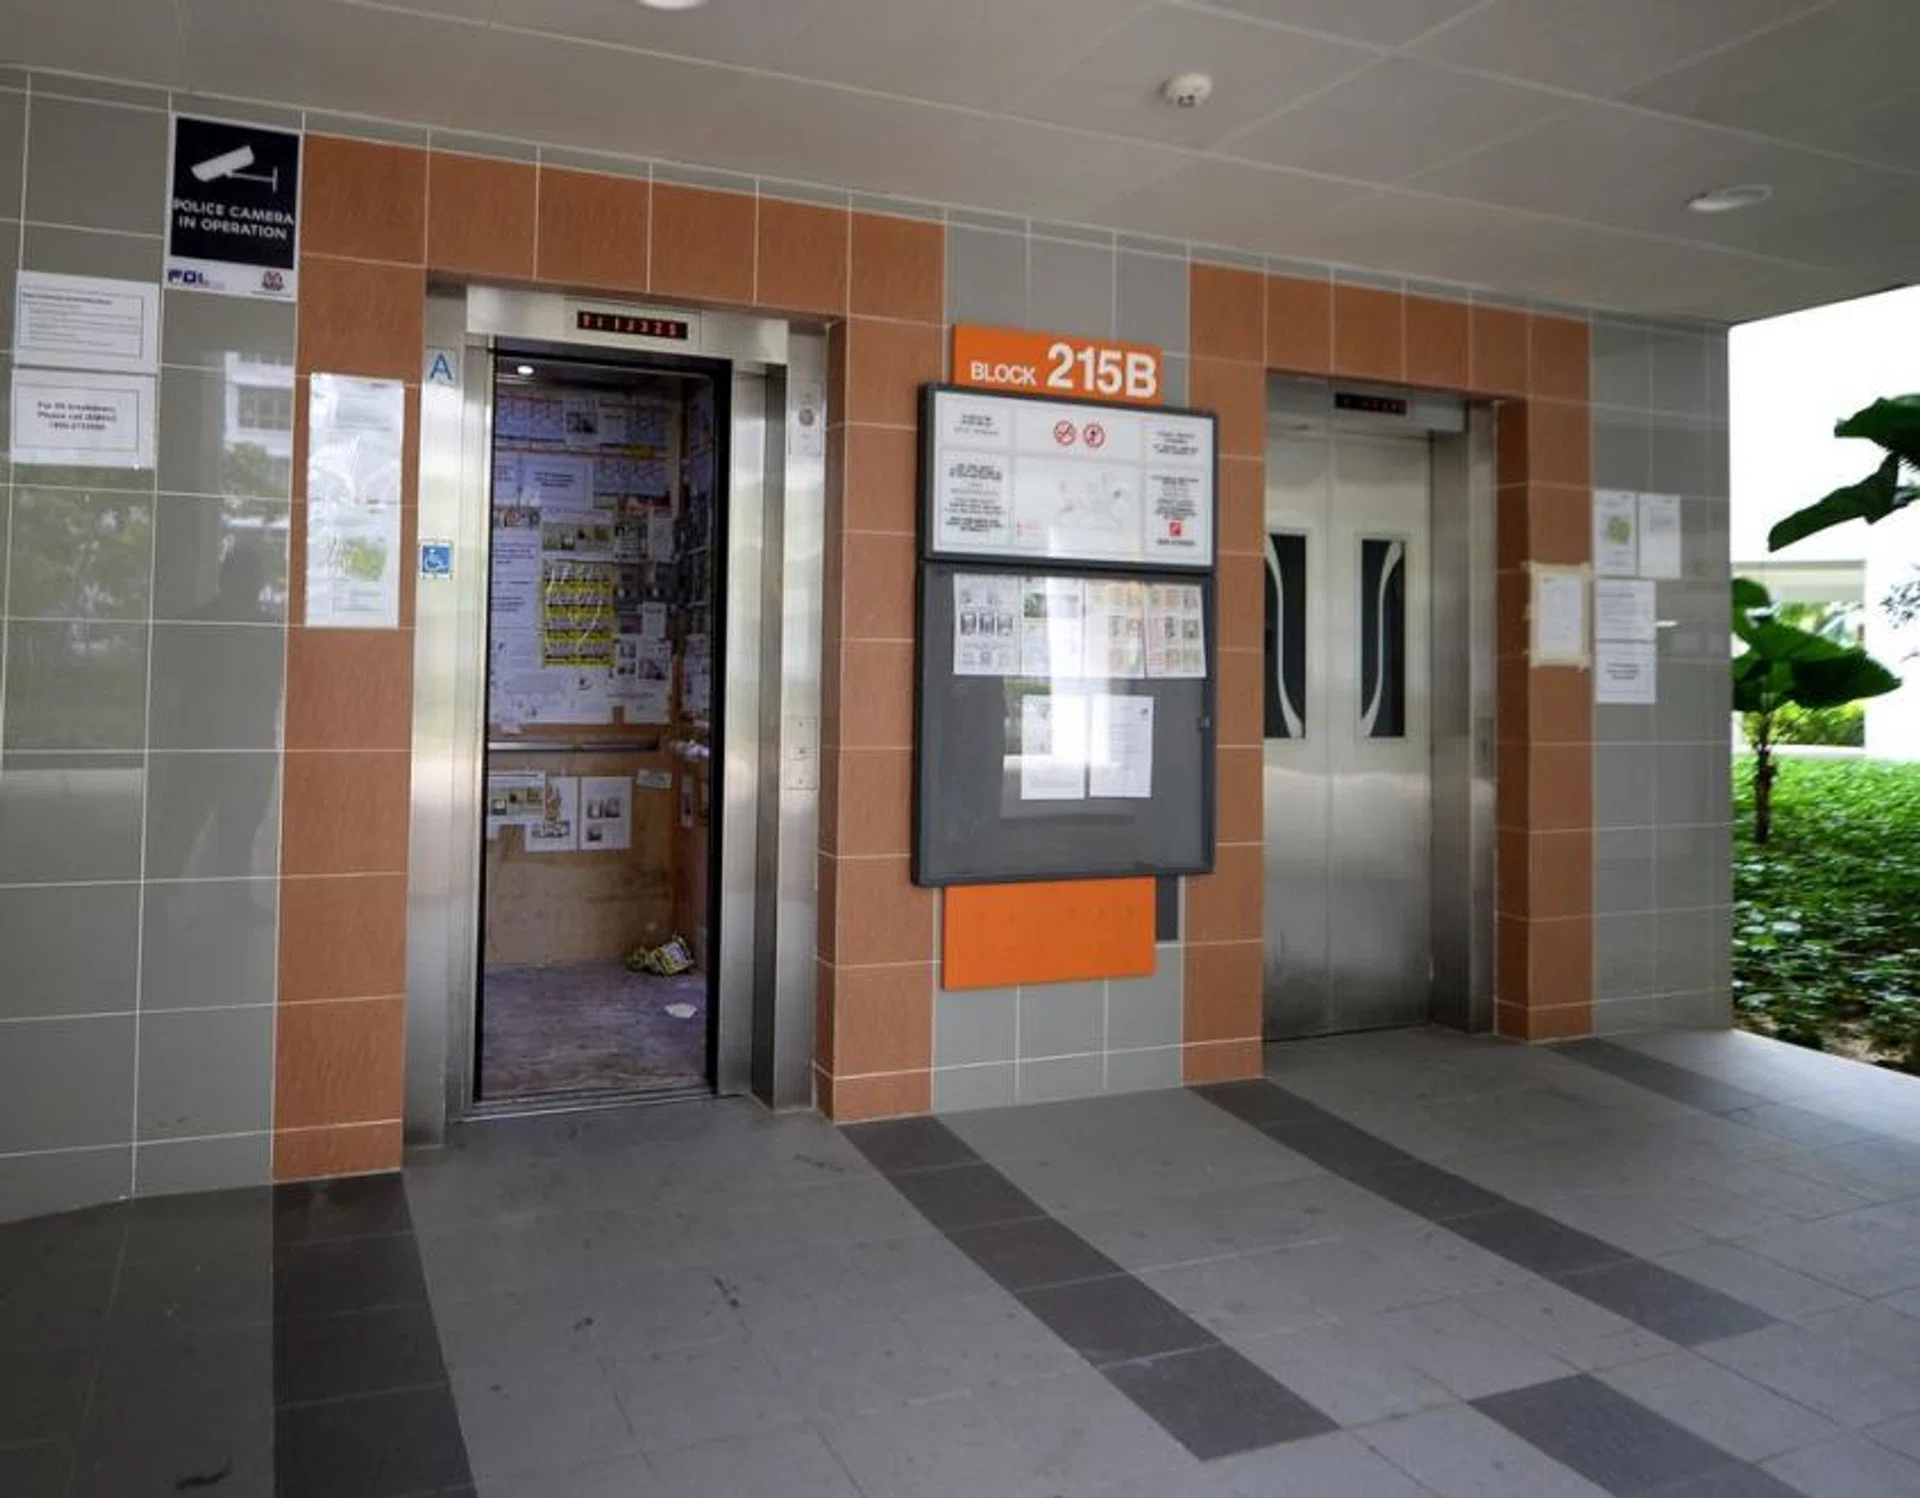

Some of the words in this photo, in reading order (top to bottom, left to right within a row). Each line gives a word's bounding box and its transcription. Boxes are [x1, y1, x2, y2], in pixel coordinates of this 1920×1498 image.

[173, 198, 225, 216] POLICE
[229, 206, 294, 225] CAMERA
[179, 216, 196, 229] IN
[201, 218, 287, 239] OPERATION
[430, 353, 453, 381] A
[970, 362, 1037, 386] BLOCK
[1046, 342, 1157, 399] 215B
